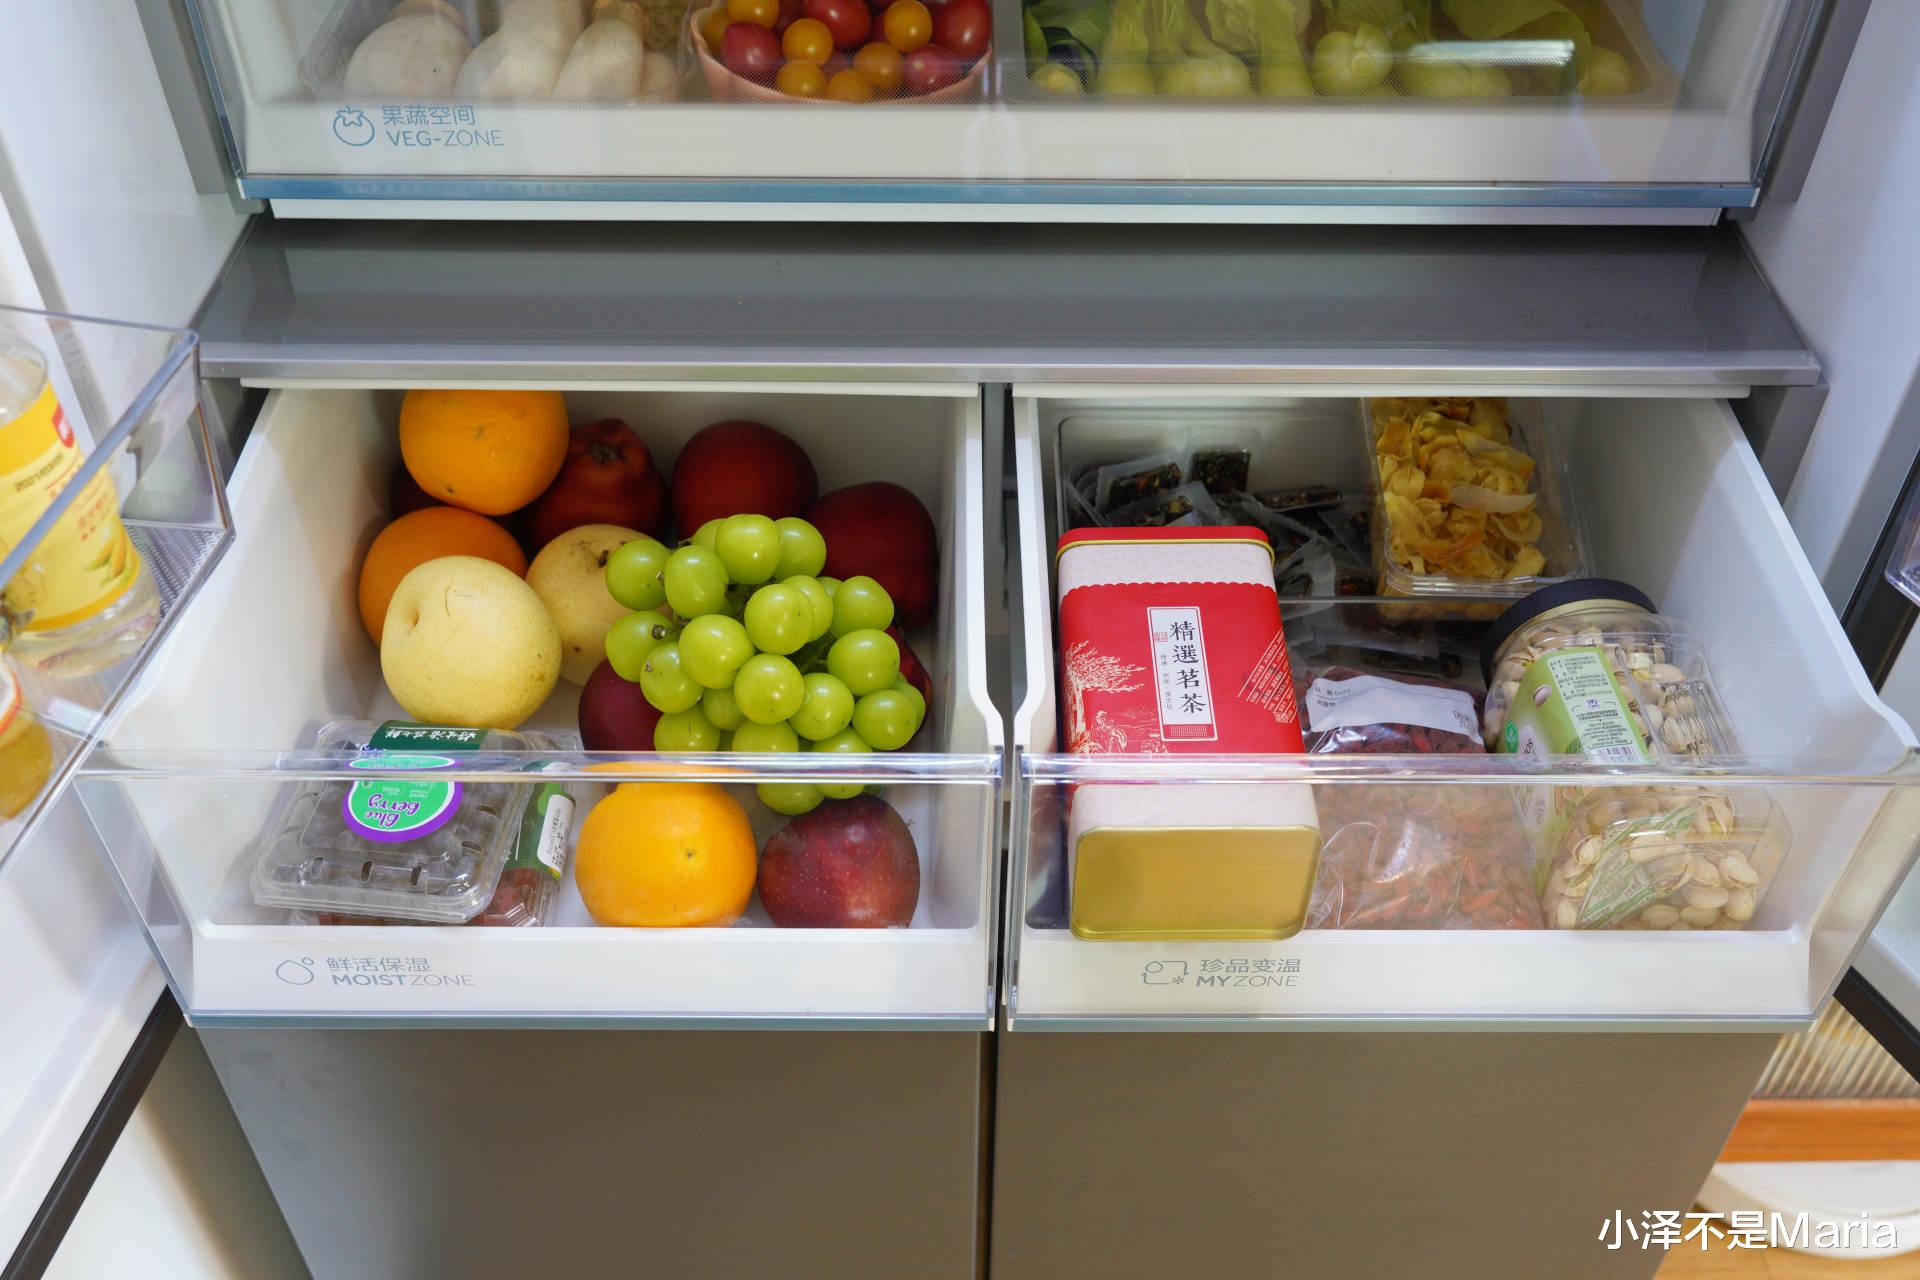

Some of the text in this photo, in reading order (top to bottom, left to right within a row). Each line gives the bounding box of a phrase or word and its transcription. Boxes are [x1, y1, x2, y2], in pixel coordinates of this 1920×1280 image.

[383, 105, 476, 126] 果蔬空间
[386, 130, 504, 146] VEG-ZONE
[1169, 620, 1207, 714] 精選茗茶
[367, 793, 420, 816] Berry
[364, 810, 400, 828] Blue
[327, 957, 431, 973] 鲜活保湿
[1201, 959, 1300, 973] 珍品变温
